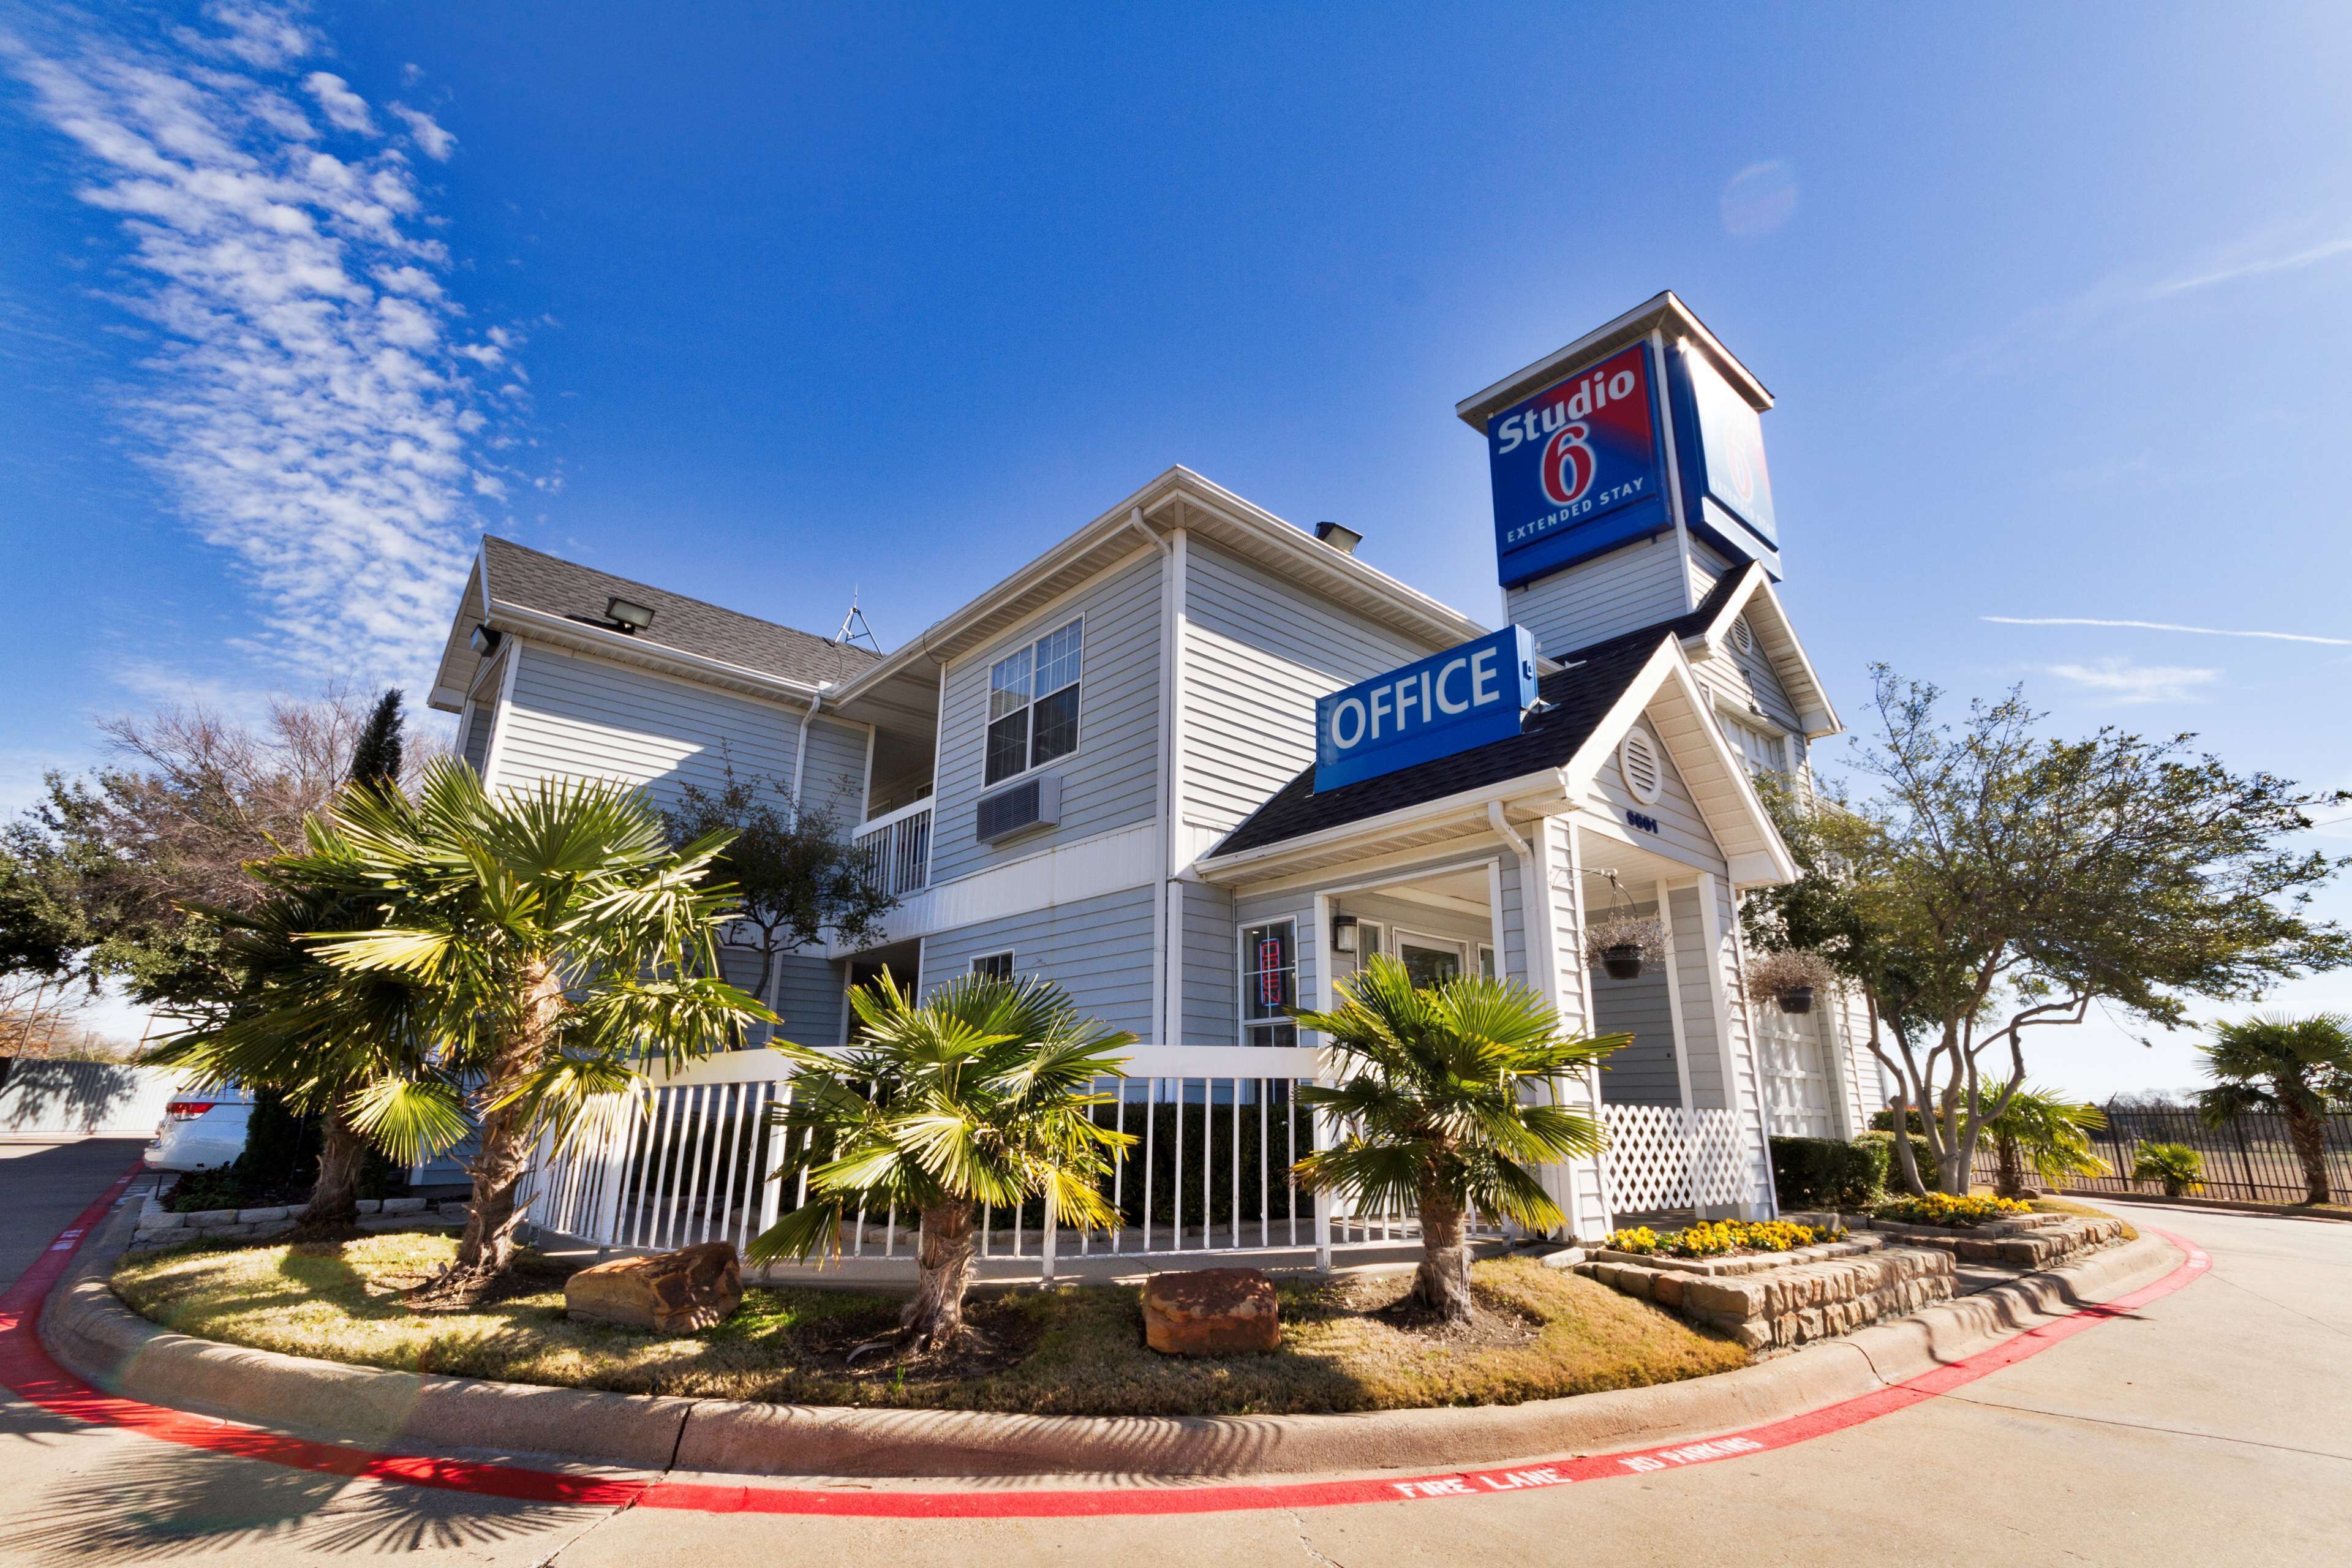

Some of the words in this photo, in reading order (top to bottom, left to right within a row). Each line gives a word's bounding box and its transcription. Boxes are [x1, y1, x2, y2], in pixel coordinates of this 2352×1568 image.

[1498, 370, 1635, 454] Studio
[1540, 422, 1596, 506] 6
[1507, 500, 1592, 543] EXTENDED
[1599, 477, 1644, 506] STAY
[1332, 646, 1500, 749] OFFICE
[1261, 941, 1281, 1005] OPEN
[1392, 1478, 1478, 1498] FIRE
[1479, 1468, 1572, 1490] LANE
[1617, 1455, 1667, 1473] NO
[1658, 1437, 1764, 1464] PARKING
